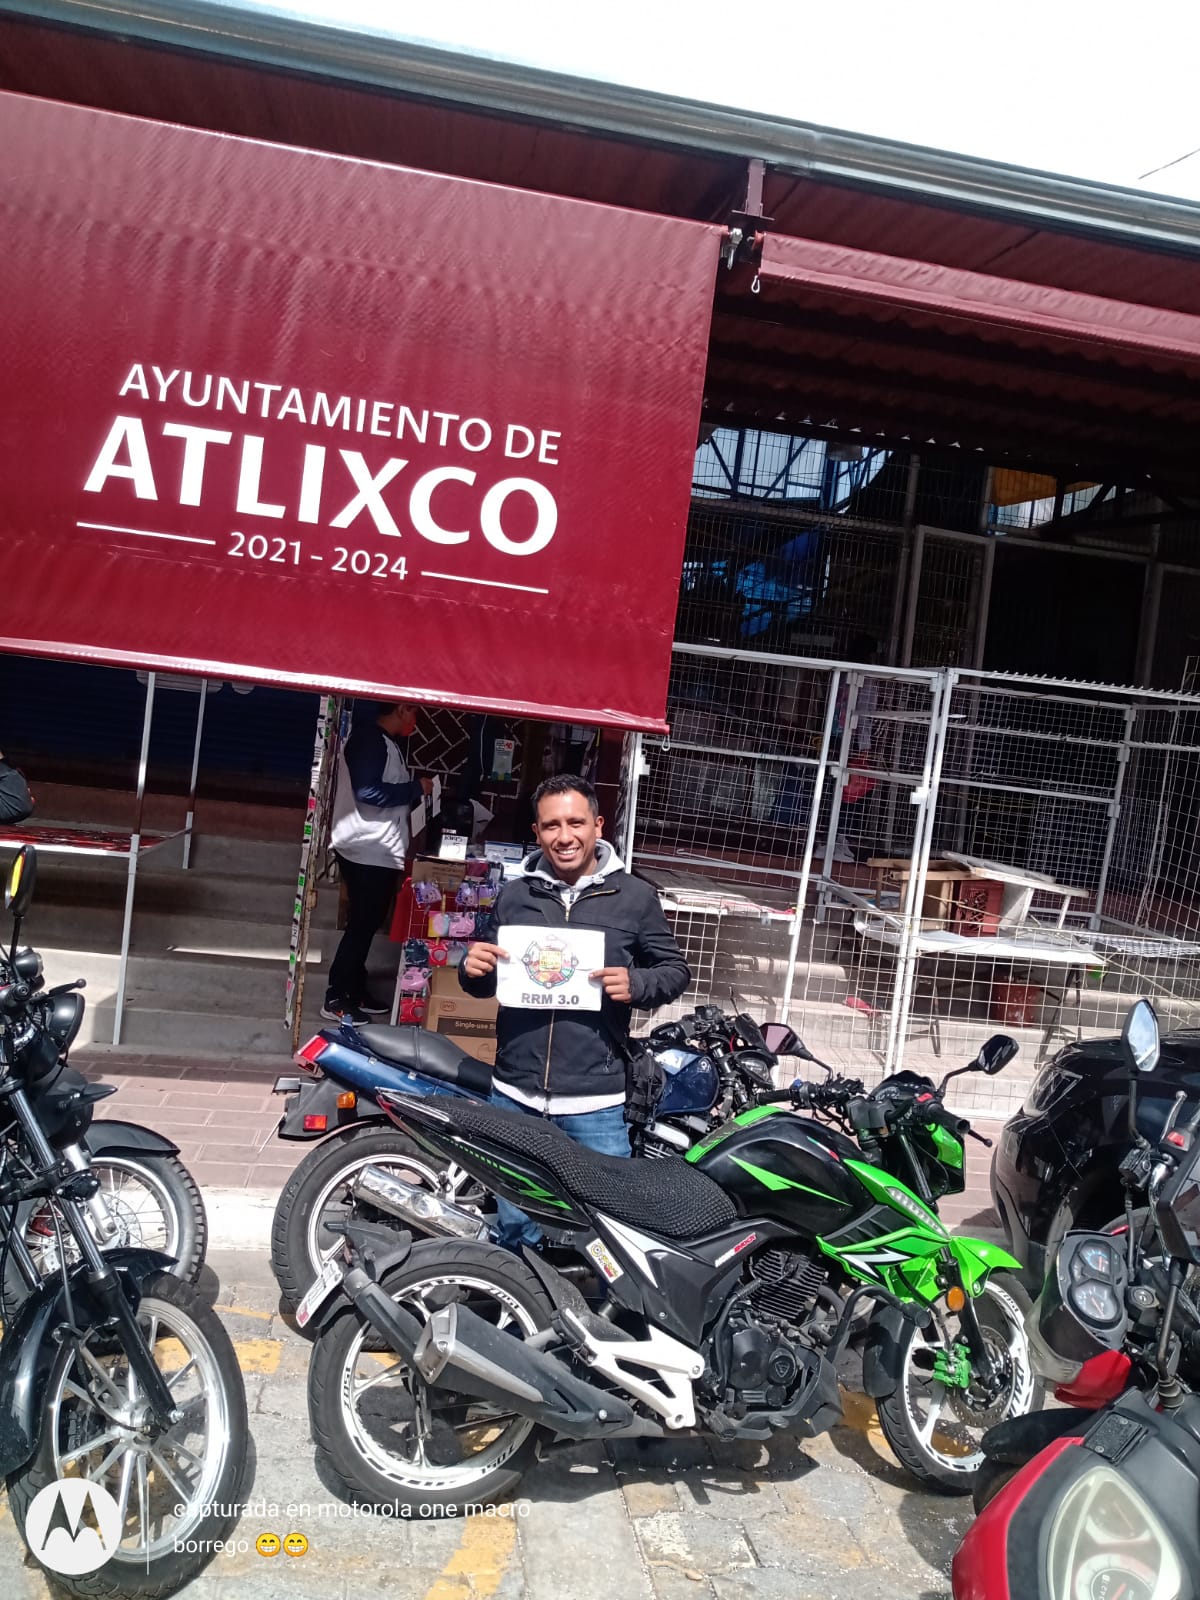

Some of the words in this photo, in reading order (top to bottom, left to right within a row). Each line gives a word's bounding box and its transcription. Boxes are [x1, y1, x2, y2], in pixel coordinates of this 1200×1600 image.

[118, 363, 492, 453] AYUNTAMIENTO
[504, 423, 562, 465] DE
[83, 415, 558, 556] ATLIXCO
[227, 531, 301, 565] 2021
[331, 546, 409, 580] 2024
[521, 992, 553, 1005] RRM
[557, 994, 580, 1005] 3.0
